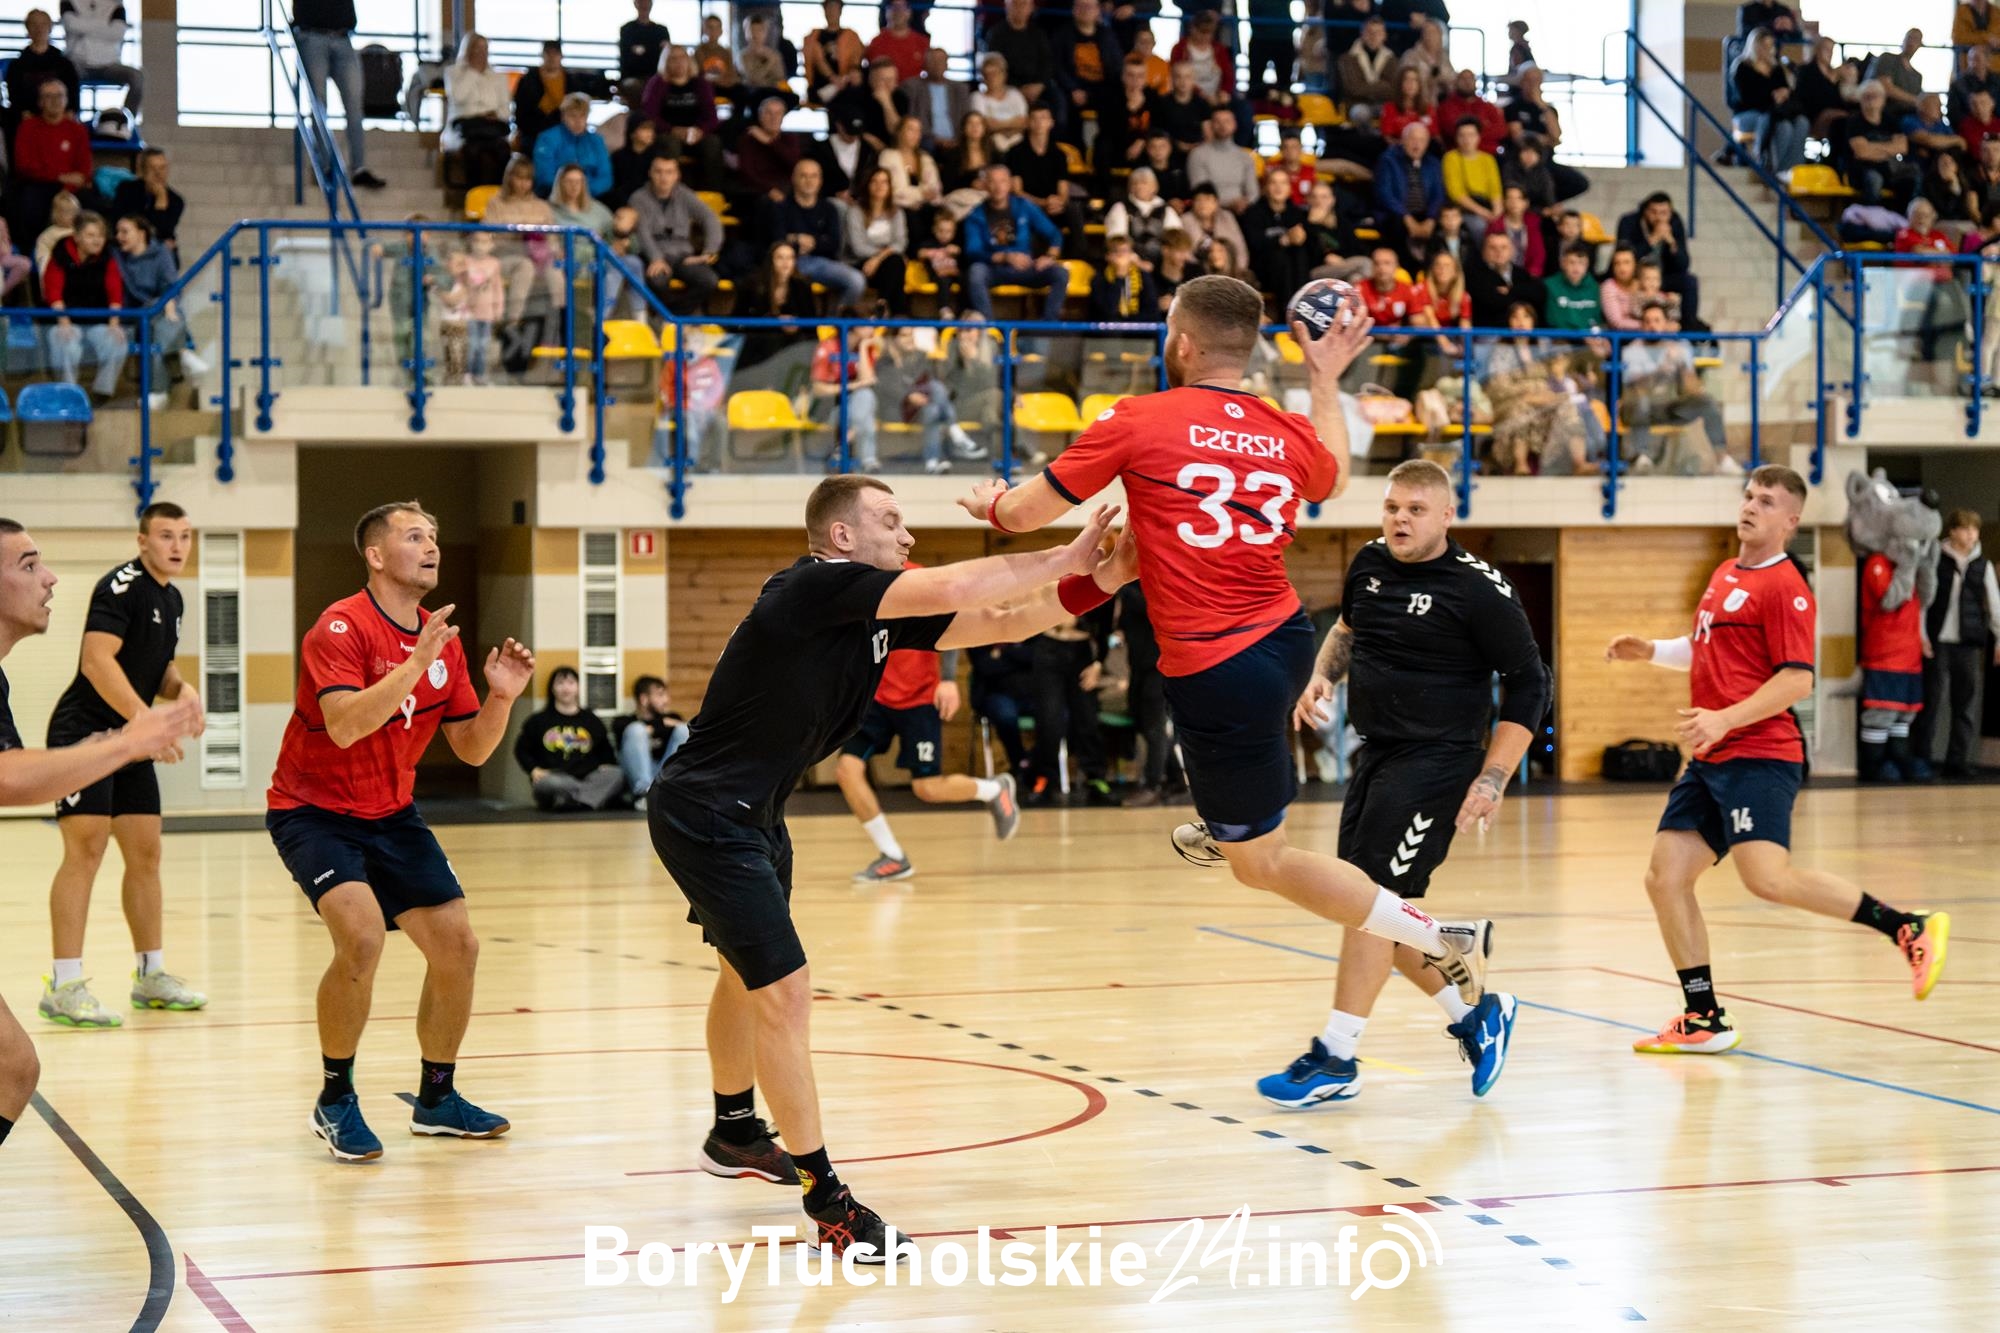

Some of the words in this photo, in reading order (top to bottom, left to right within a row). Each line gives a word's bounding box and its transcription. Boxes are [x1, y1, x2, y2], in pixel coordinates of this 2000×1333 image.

[1296, 300, 1334, 330] SELEC
[1189, 425, 1285, 460] CZERSK
[1177, 462, 1294, 548] 33
[1407, 593, 1432, 615] 19
[400, 694, 417, 730] 9
[916, 741, 934, 762] 12
[1730, 807, 1754, 834] 14
[313, 868, 335, 886] Kempa
